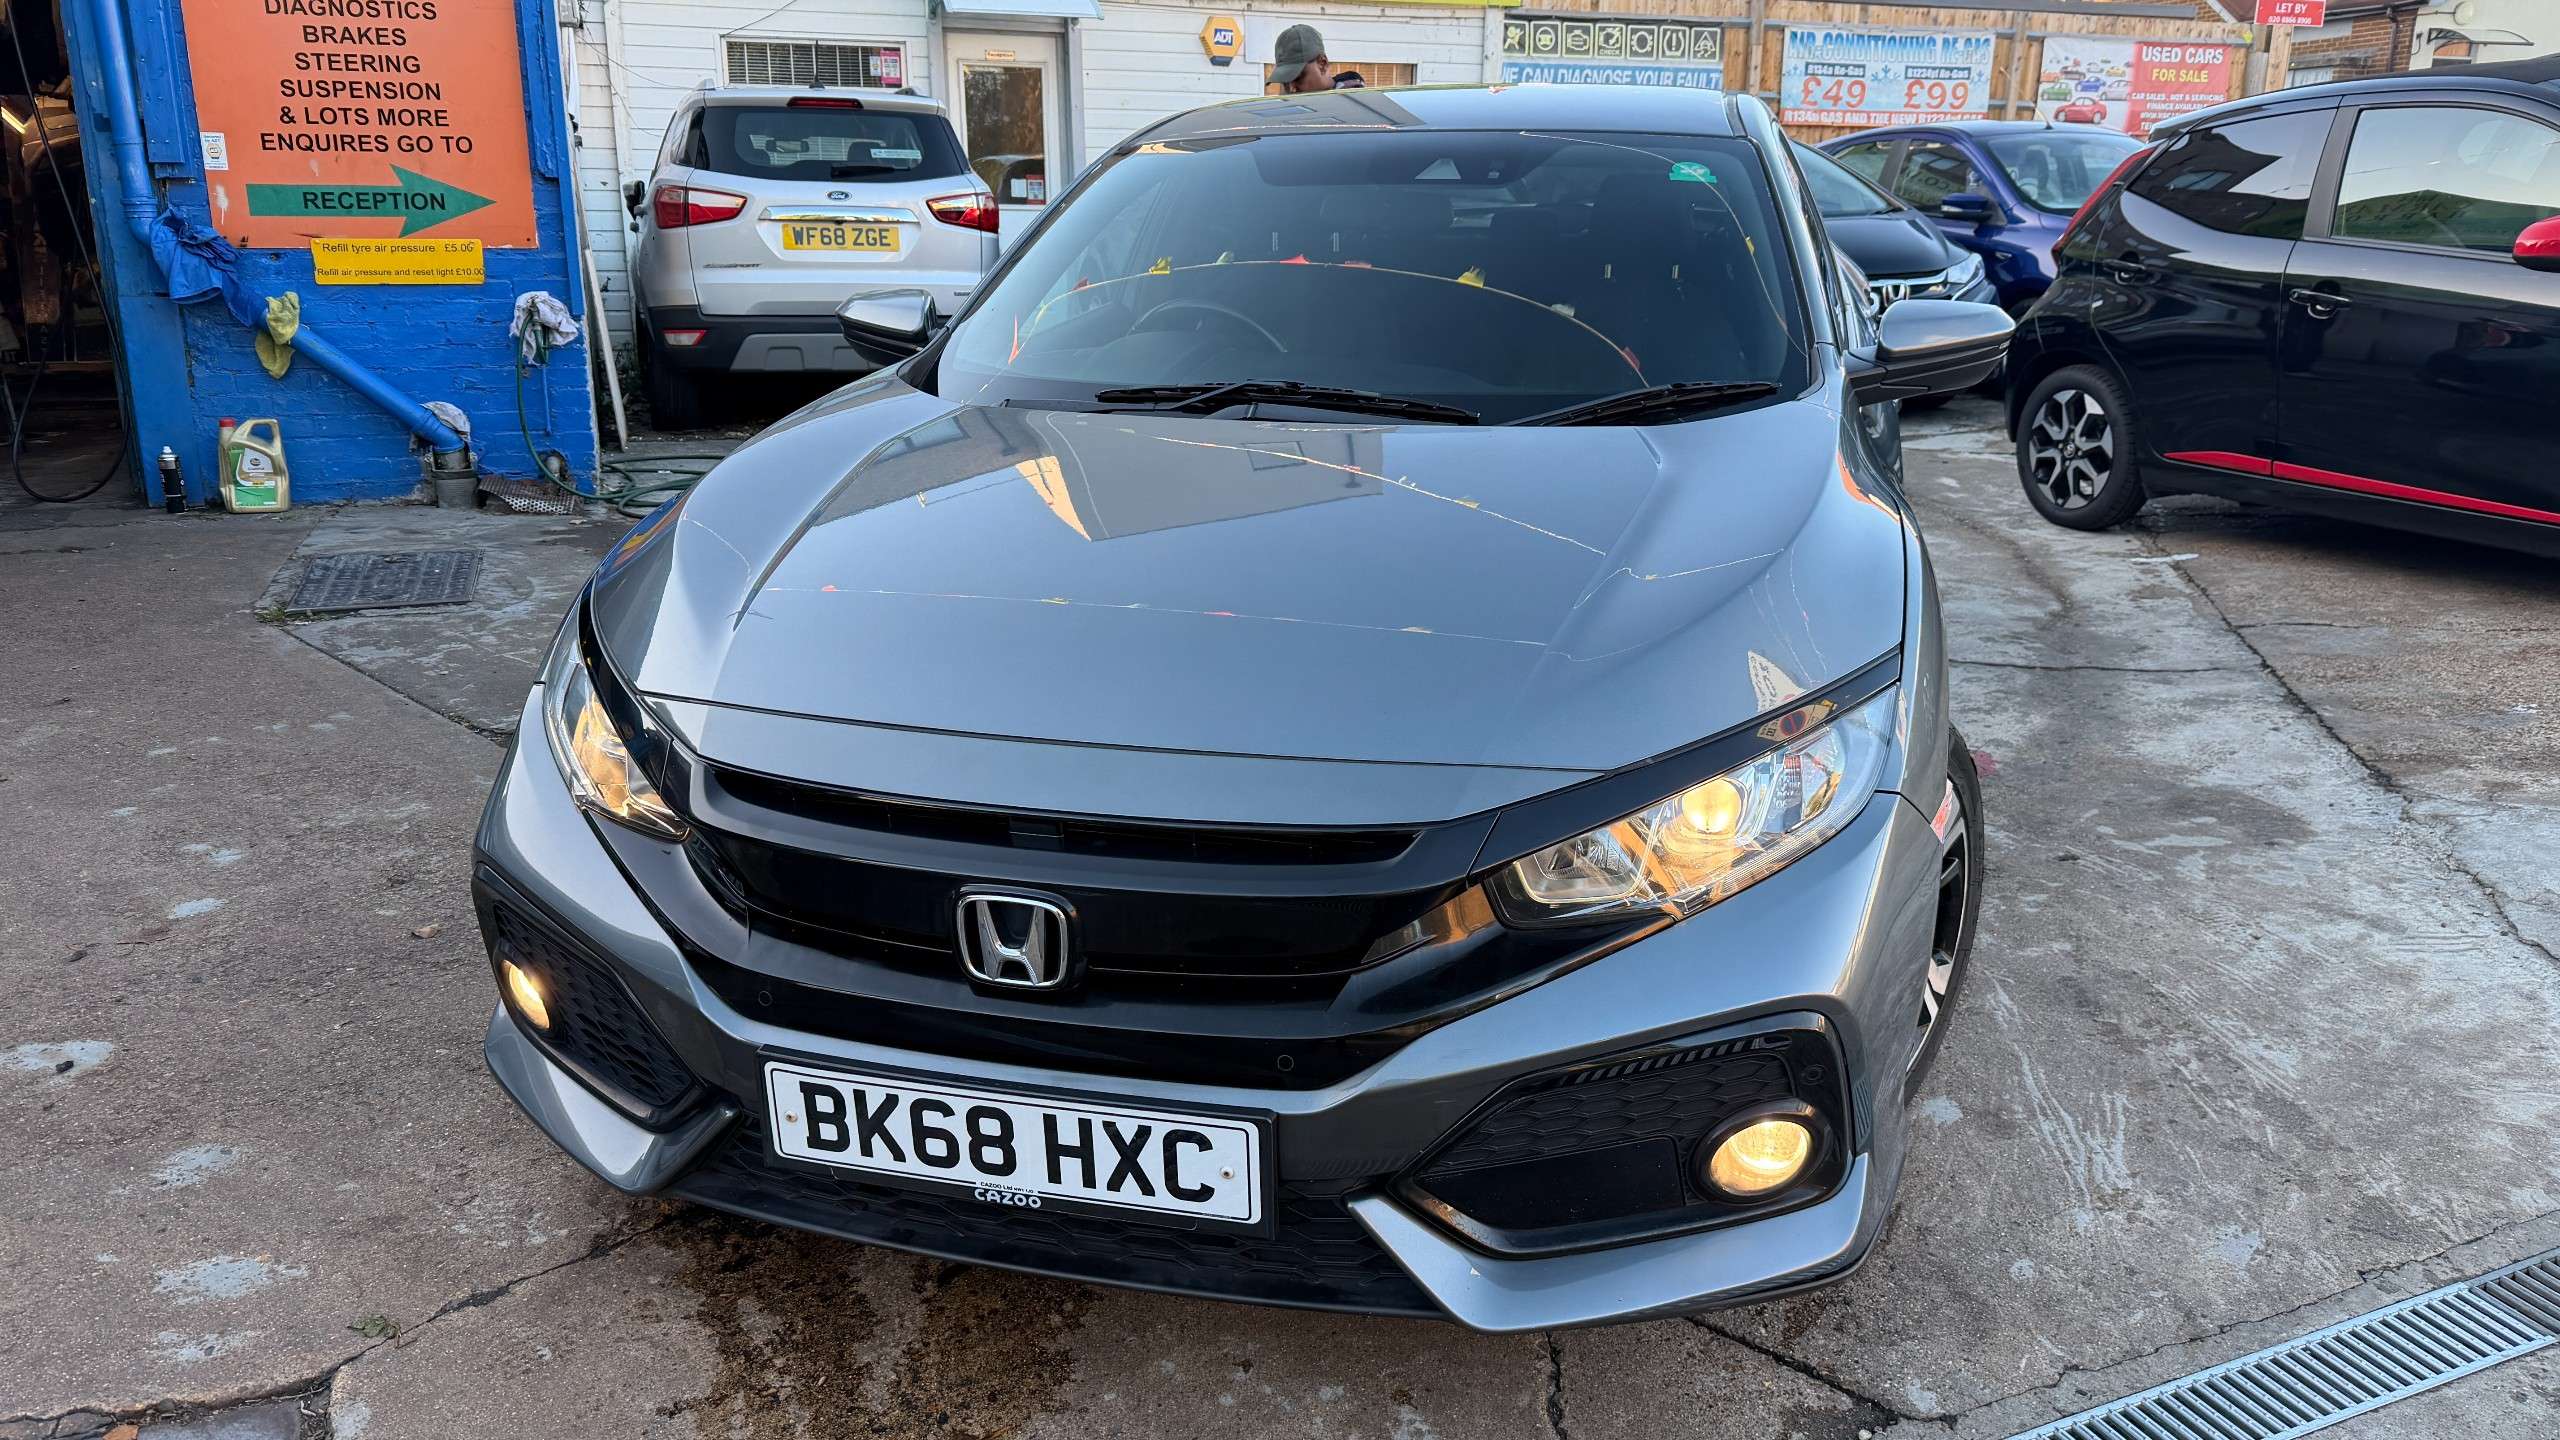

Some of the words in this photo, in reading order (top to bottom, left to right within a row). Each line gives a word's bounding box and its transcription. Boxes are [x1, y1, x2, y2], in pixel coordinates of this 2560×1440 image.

[264, 0, 438, 21] DIAGNOSTICS
[2275, 2, 2293, 14] LET
[2294, 3, 2308, 14] BY
[302, 24, 407, 46] BRAKES
[1214, 31, 1233, 44] ADT
[294, 52, 421, 74] STEERING
[2141, 45, 2182, 63] USED
[2185, 47, 2225, 64] CARS
[1521, 67, 1554, 83] CAN
[1556, 69, 1632, 85] DIAGNOSE
[1635, 71, 1674, 86] YOUR
[2151, 68, 2177, 83] FOR
[2179, 69, 2209, 83] SALE
[279, 78, 441, 101] SUSPENSION
[1801, 76, 1868, 109] £49
[1904, 79, 1970, 110] £99
[279, 105, 297, 125] &
[304, 106, 370, 126] LOTS
[377, 108, 450, 127] MORE
[1821, 111, 1843, 123] GAS
[1845, 112, 1867, 124] AND
[1870, 112, 1890, 125] THE
[260, 132, 389, 153] ENQUIRES
[396, 135, 434, 154] GO
[440, 135, 473, 154] TO
[302, 191, 447, 211] RECEPTION
[792, 225, 846, 247] WF68
[852, 227, 892, 247] ZGE
[322, 242, 349, 252] Refill
[351, 243, 371, 254] tyre
[374, 242, 387, 252] air
[390, 244, 435, 254] pressure
[317, 268, 339, 276] Refill
[341, 268, 352, 276] air
[354, 269, 392, 278] pressure
[394, 268, 411, 276] and
[436, 268, 454, 278] light
[798, 1080, 1018, 1178] BK68
[1042, 1112, 1215, 1204] HXC
[980, 1181, 1002, 1189] CAZOO
[974, 1188, 1042, 1208] CAZOO
